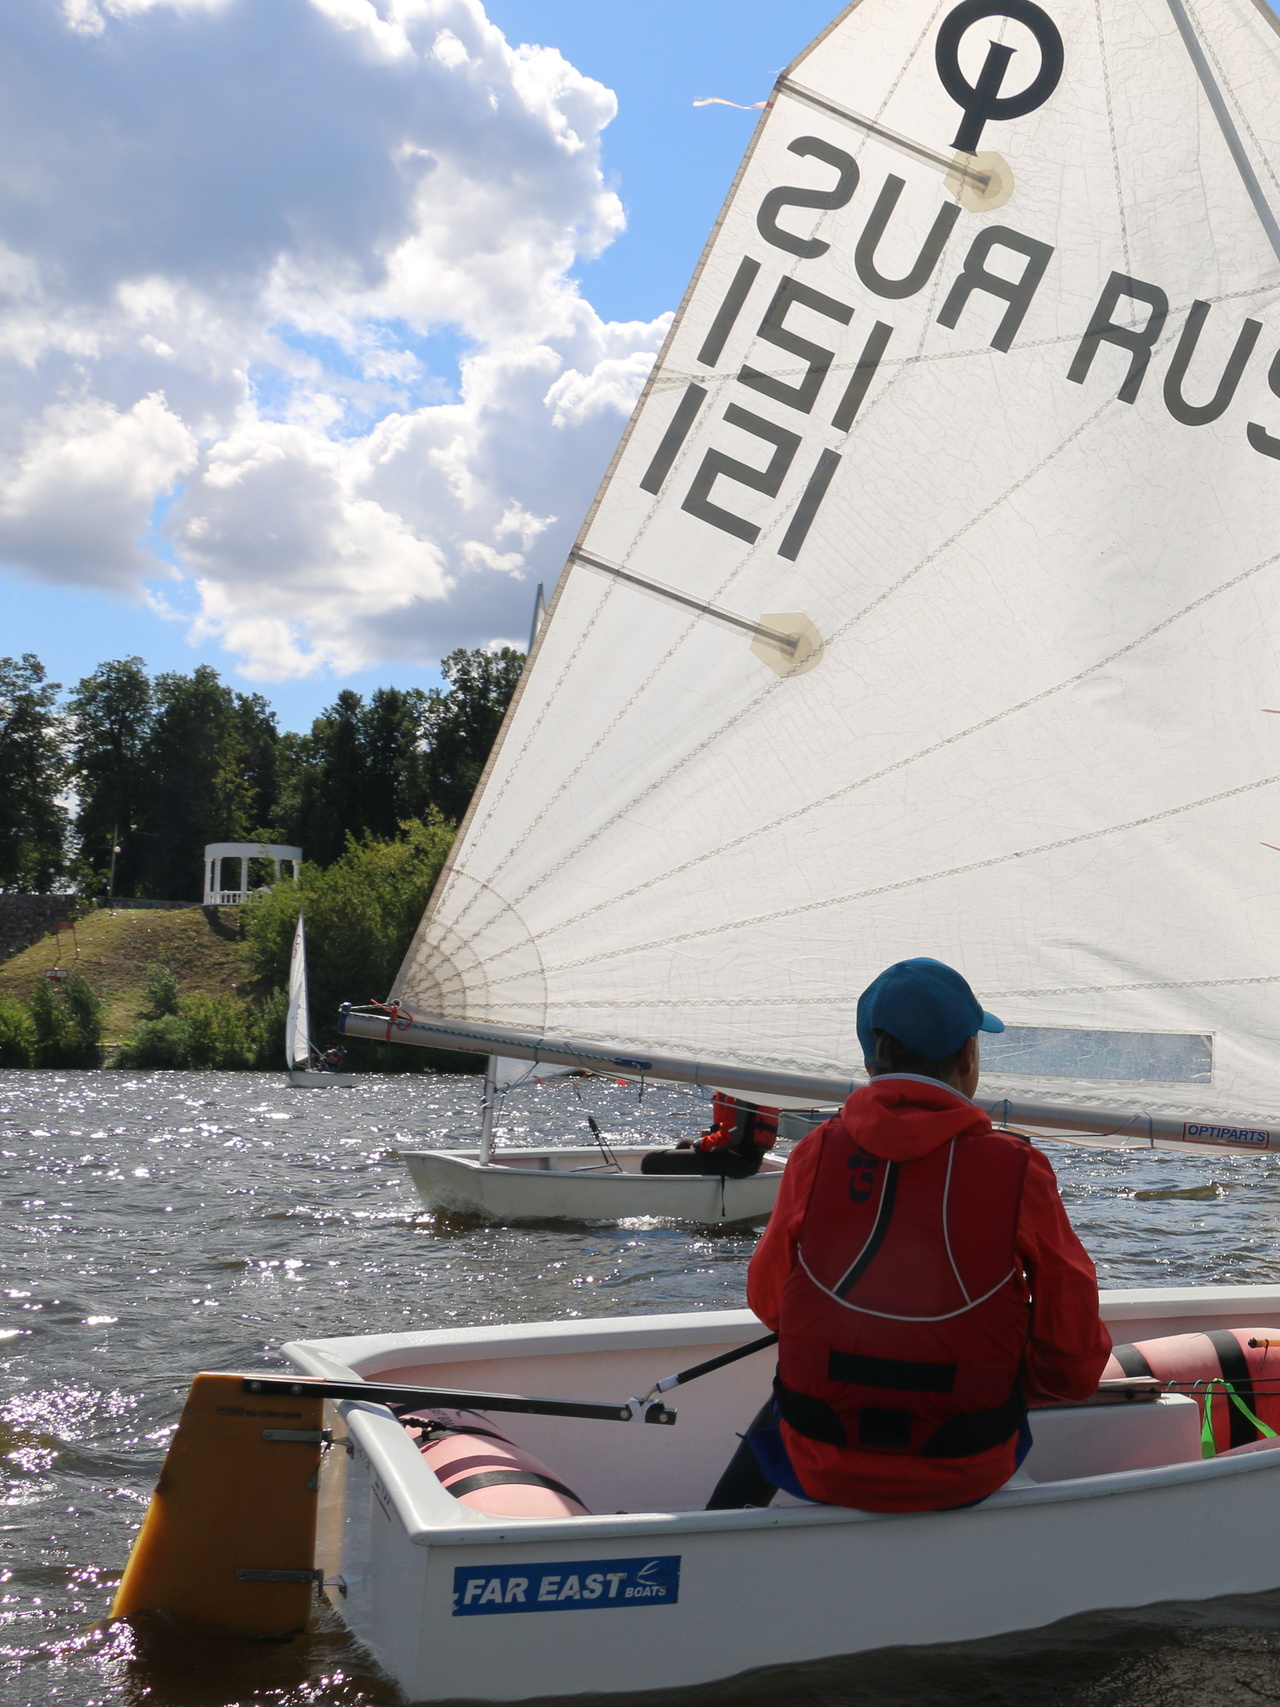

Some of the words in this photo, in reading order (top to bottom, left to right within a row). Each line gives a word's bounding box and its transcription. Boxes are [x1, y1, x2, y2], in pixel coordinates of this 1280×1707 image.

[1188, 1125, 1266, 1142] OPTIPARTS
[463, 1577, 529, 1605] FAR
[537, 1572, 628, 1601] EAST
[624, 1585, 667, 1598] BOATS
